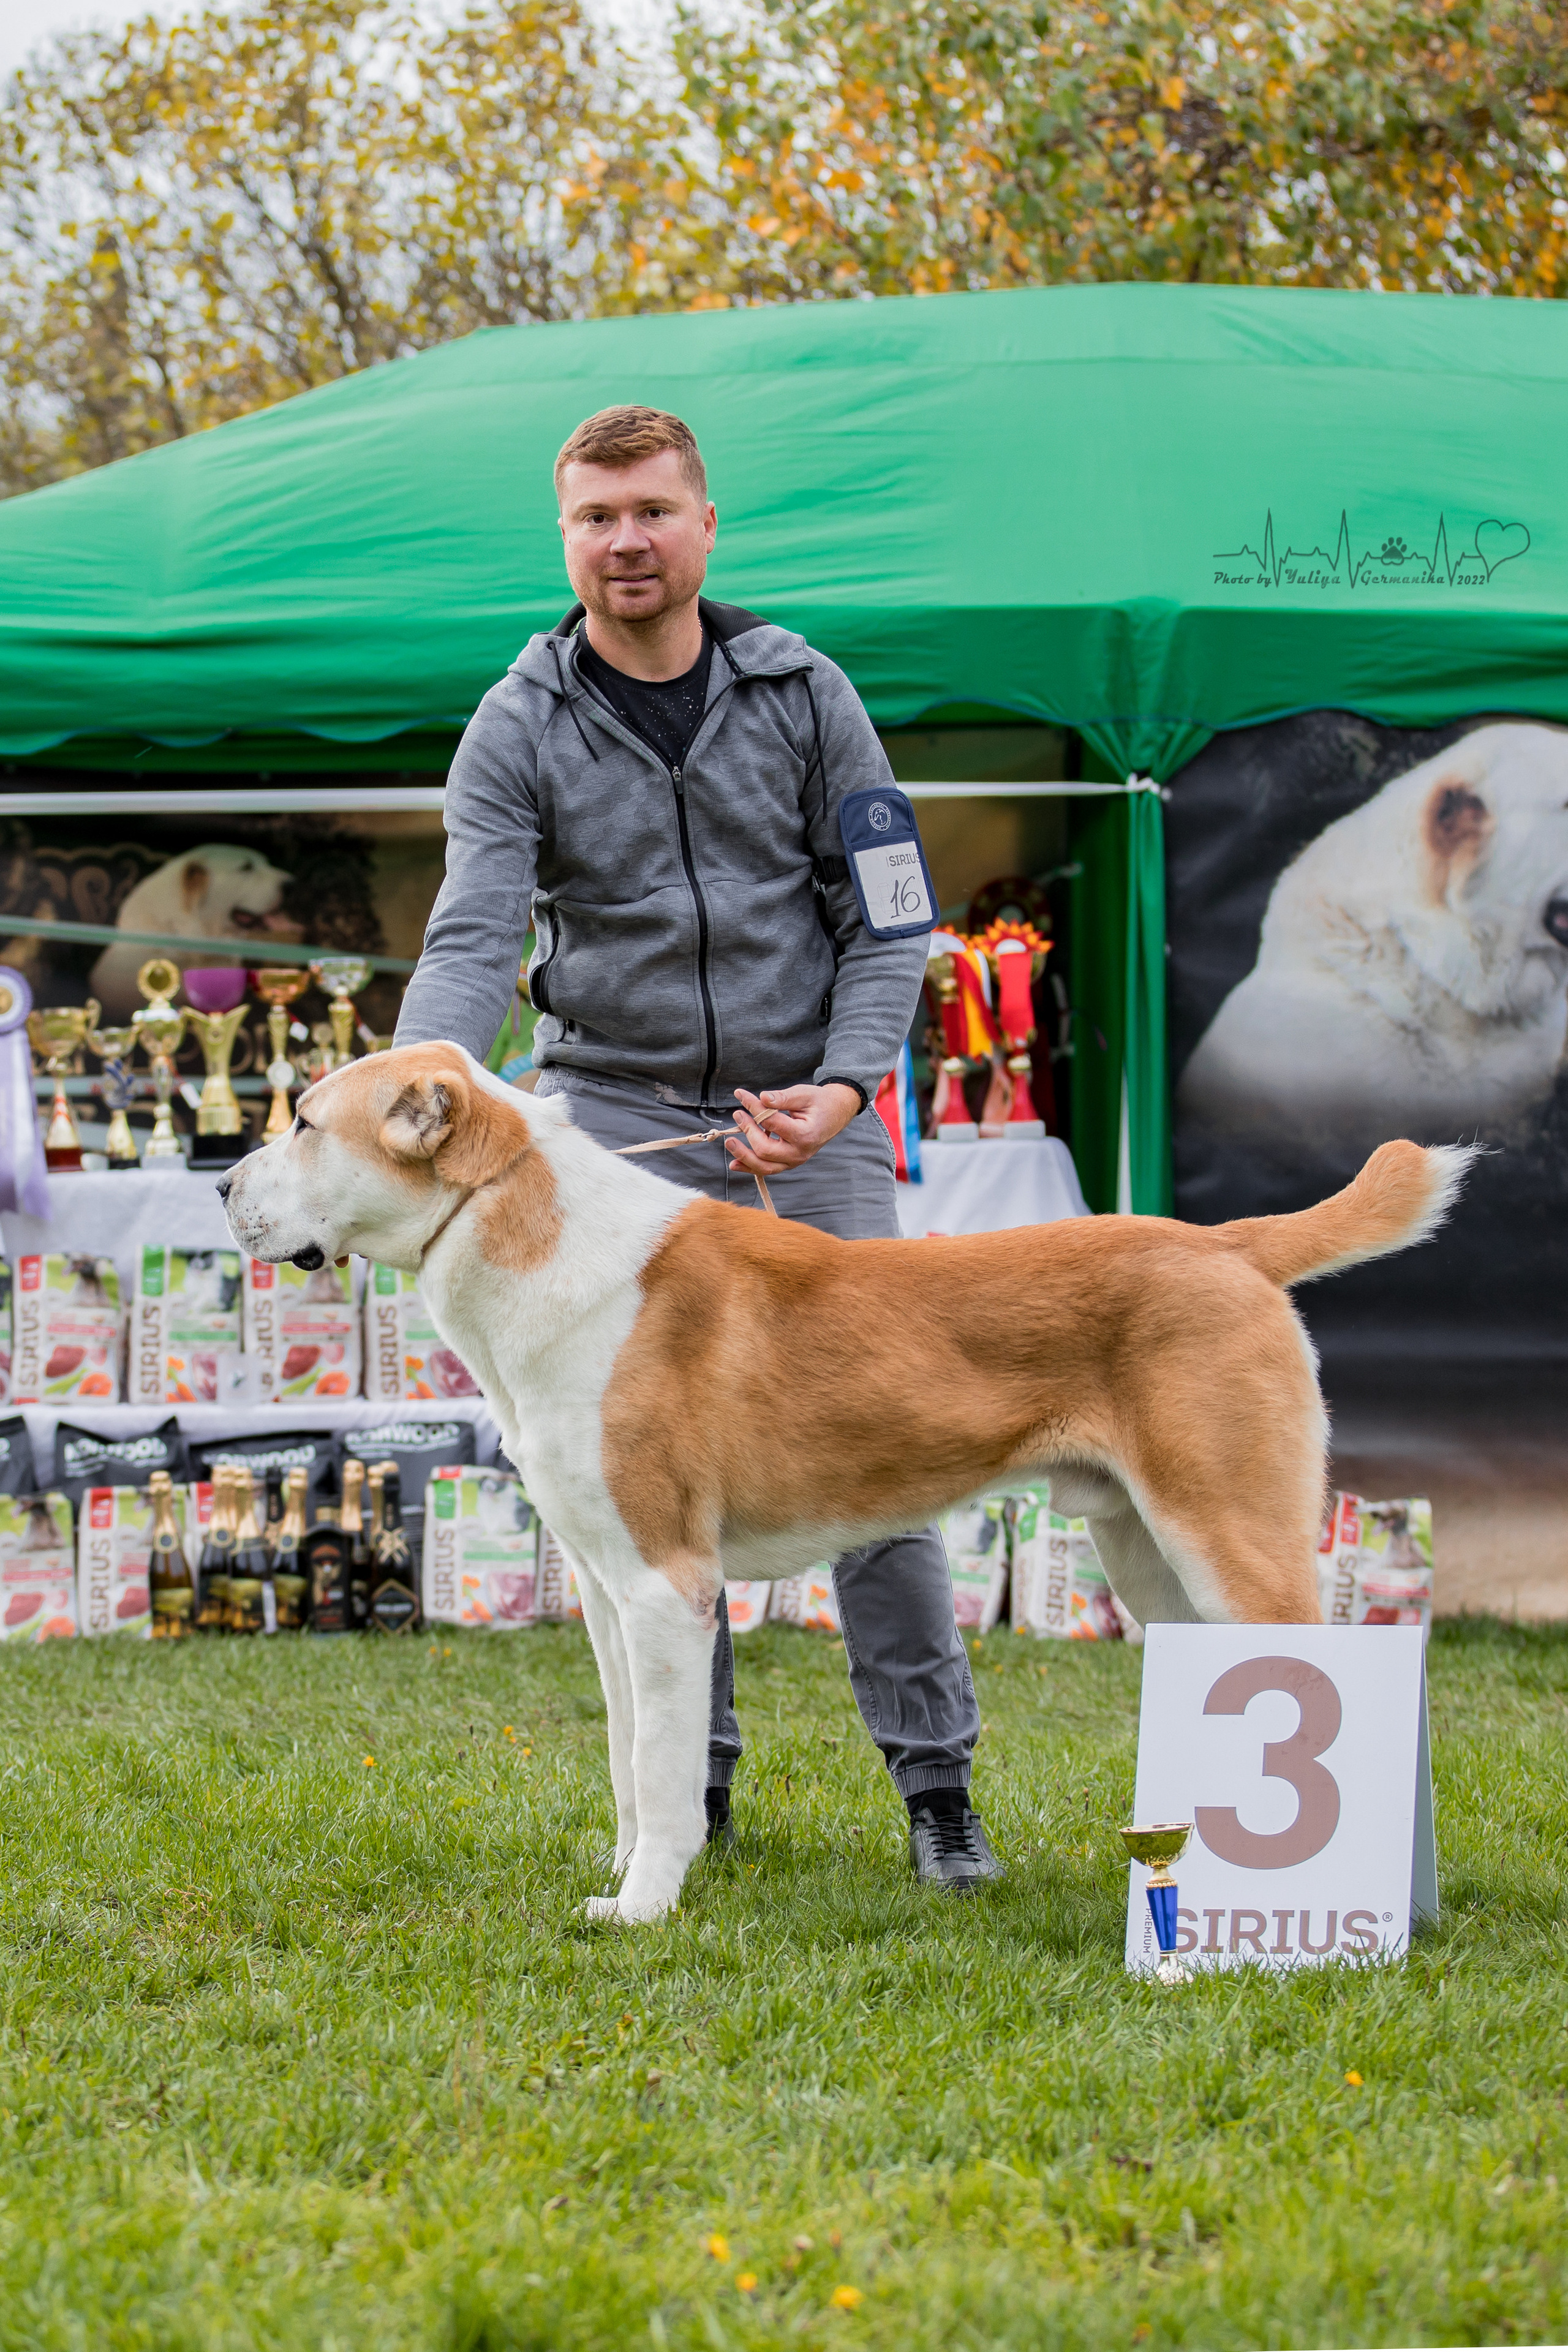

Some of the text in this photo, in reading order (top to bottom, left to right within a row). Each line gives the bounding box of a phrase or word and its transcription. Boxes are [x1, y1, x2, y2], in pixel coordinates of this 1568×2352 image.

[889, 852, 920, 867] SIRIUS
[890, 876, 920, 919] 16
[18, 1300, 40, 1386] SIRIUS
[140, 1305, 161, 1395] SIRIUS
[377, 1304, 401, 1395] SIRIUS
[90, 1538, 111, 1629] SIRIUS
[434, 1529, 455, 1611] SIRIUS
[542, 1529, 563, 1611] SIRIU
[1047, 1536, 1068, 1627] SIRIUS
[1332, 1554, 1357, 1624] RIUS
[1194, 1656, 1341, 1869] 3
